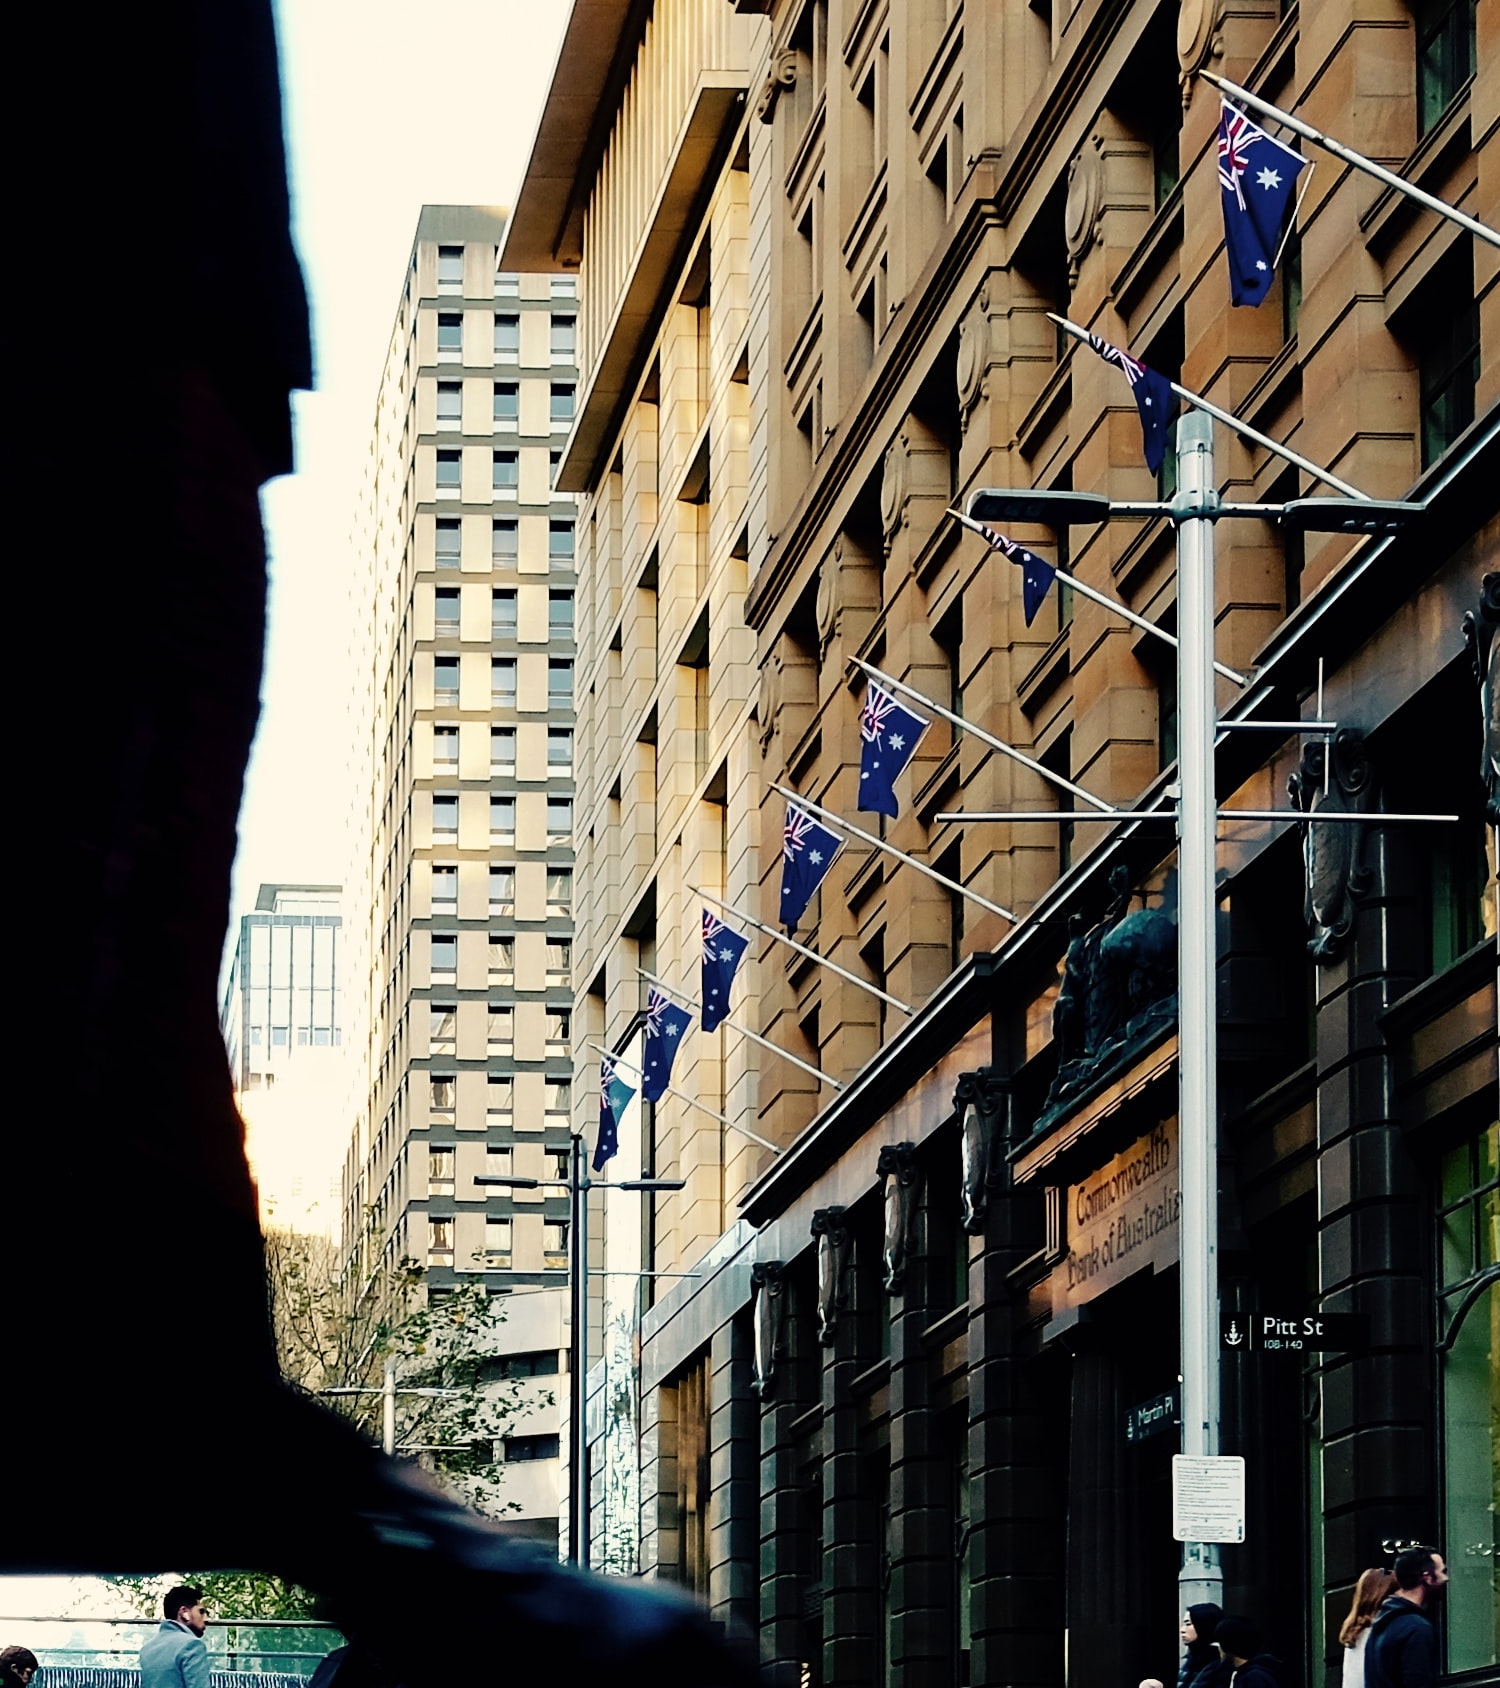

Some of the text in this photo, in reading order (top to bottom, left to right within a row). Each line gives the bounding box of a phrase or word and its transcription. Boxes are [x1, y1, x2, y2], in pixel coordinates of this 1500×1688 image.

[1066, 1235, 1099, 1291] Bank
[1102, 1222, 1115, 1268] of
[1263, 1316, 1324, 1336] Pitt St
[1137, 1402, 1164, 1428] Martin
